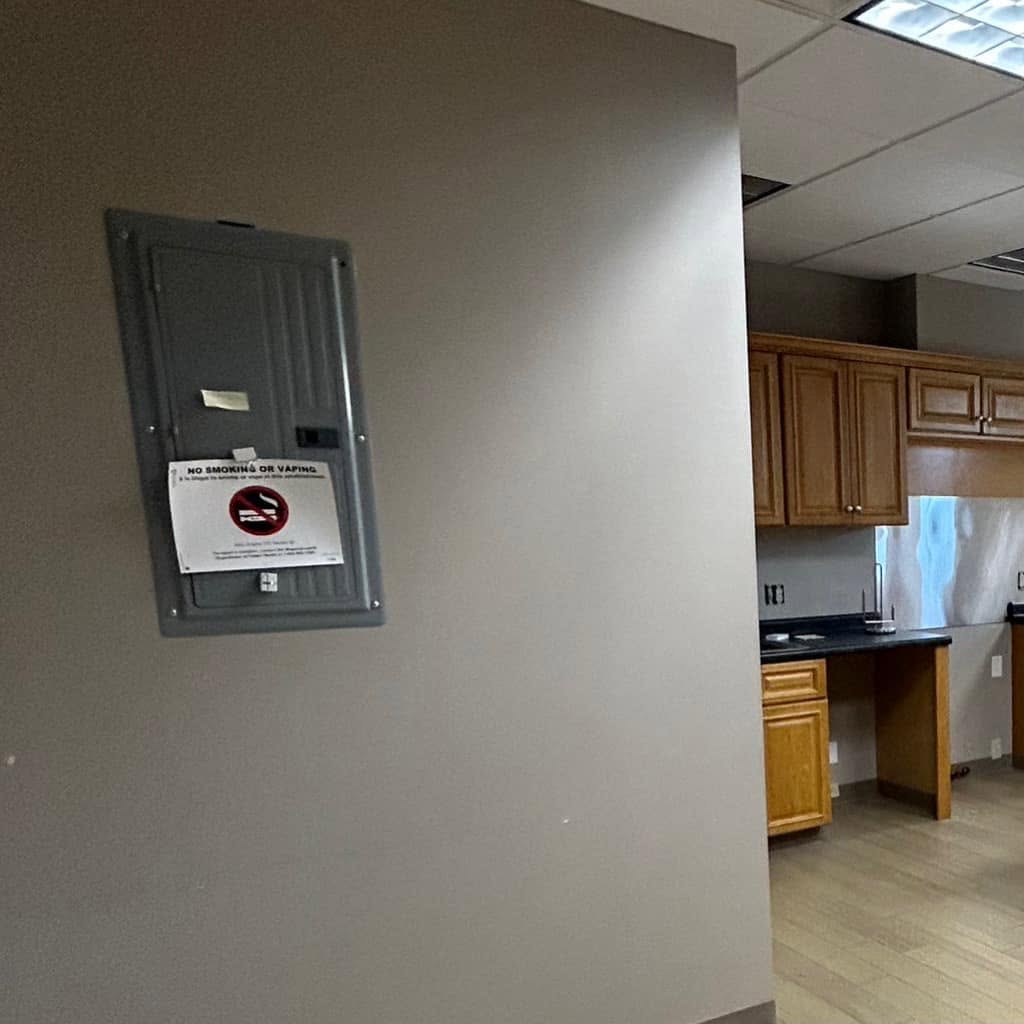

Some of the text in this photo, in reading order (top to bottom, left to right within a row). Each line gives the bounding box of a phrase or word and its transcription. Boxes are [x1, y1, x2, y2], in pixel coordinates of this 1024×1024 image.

[187, 465, 317, 475] NO SMOKING OR VAPING
